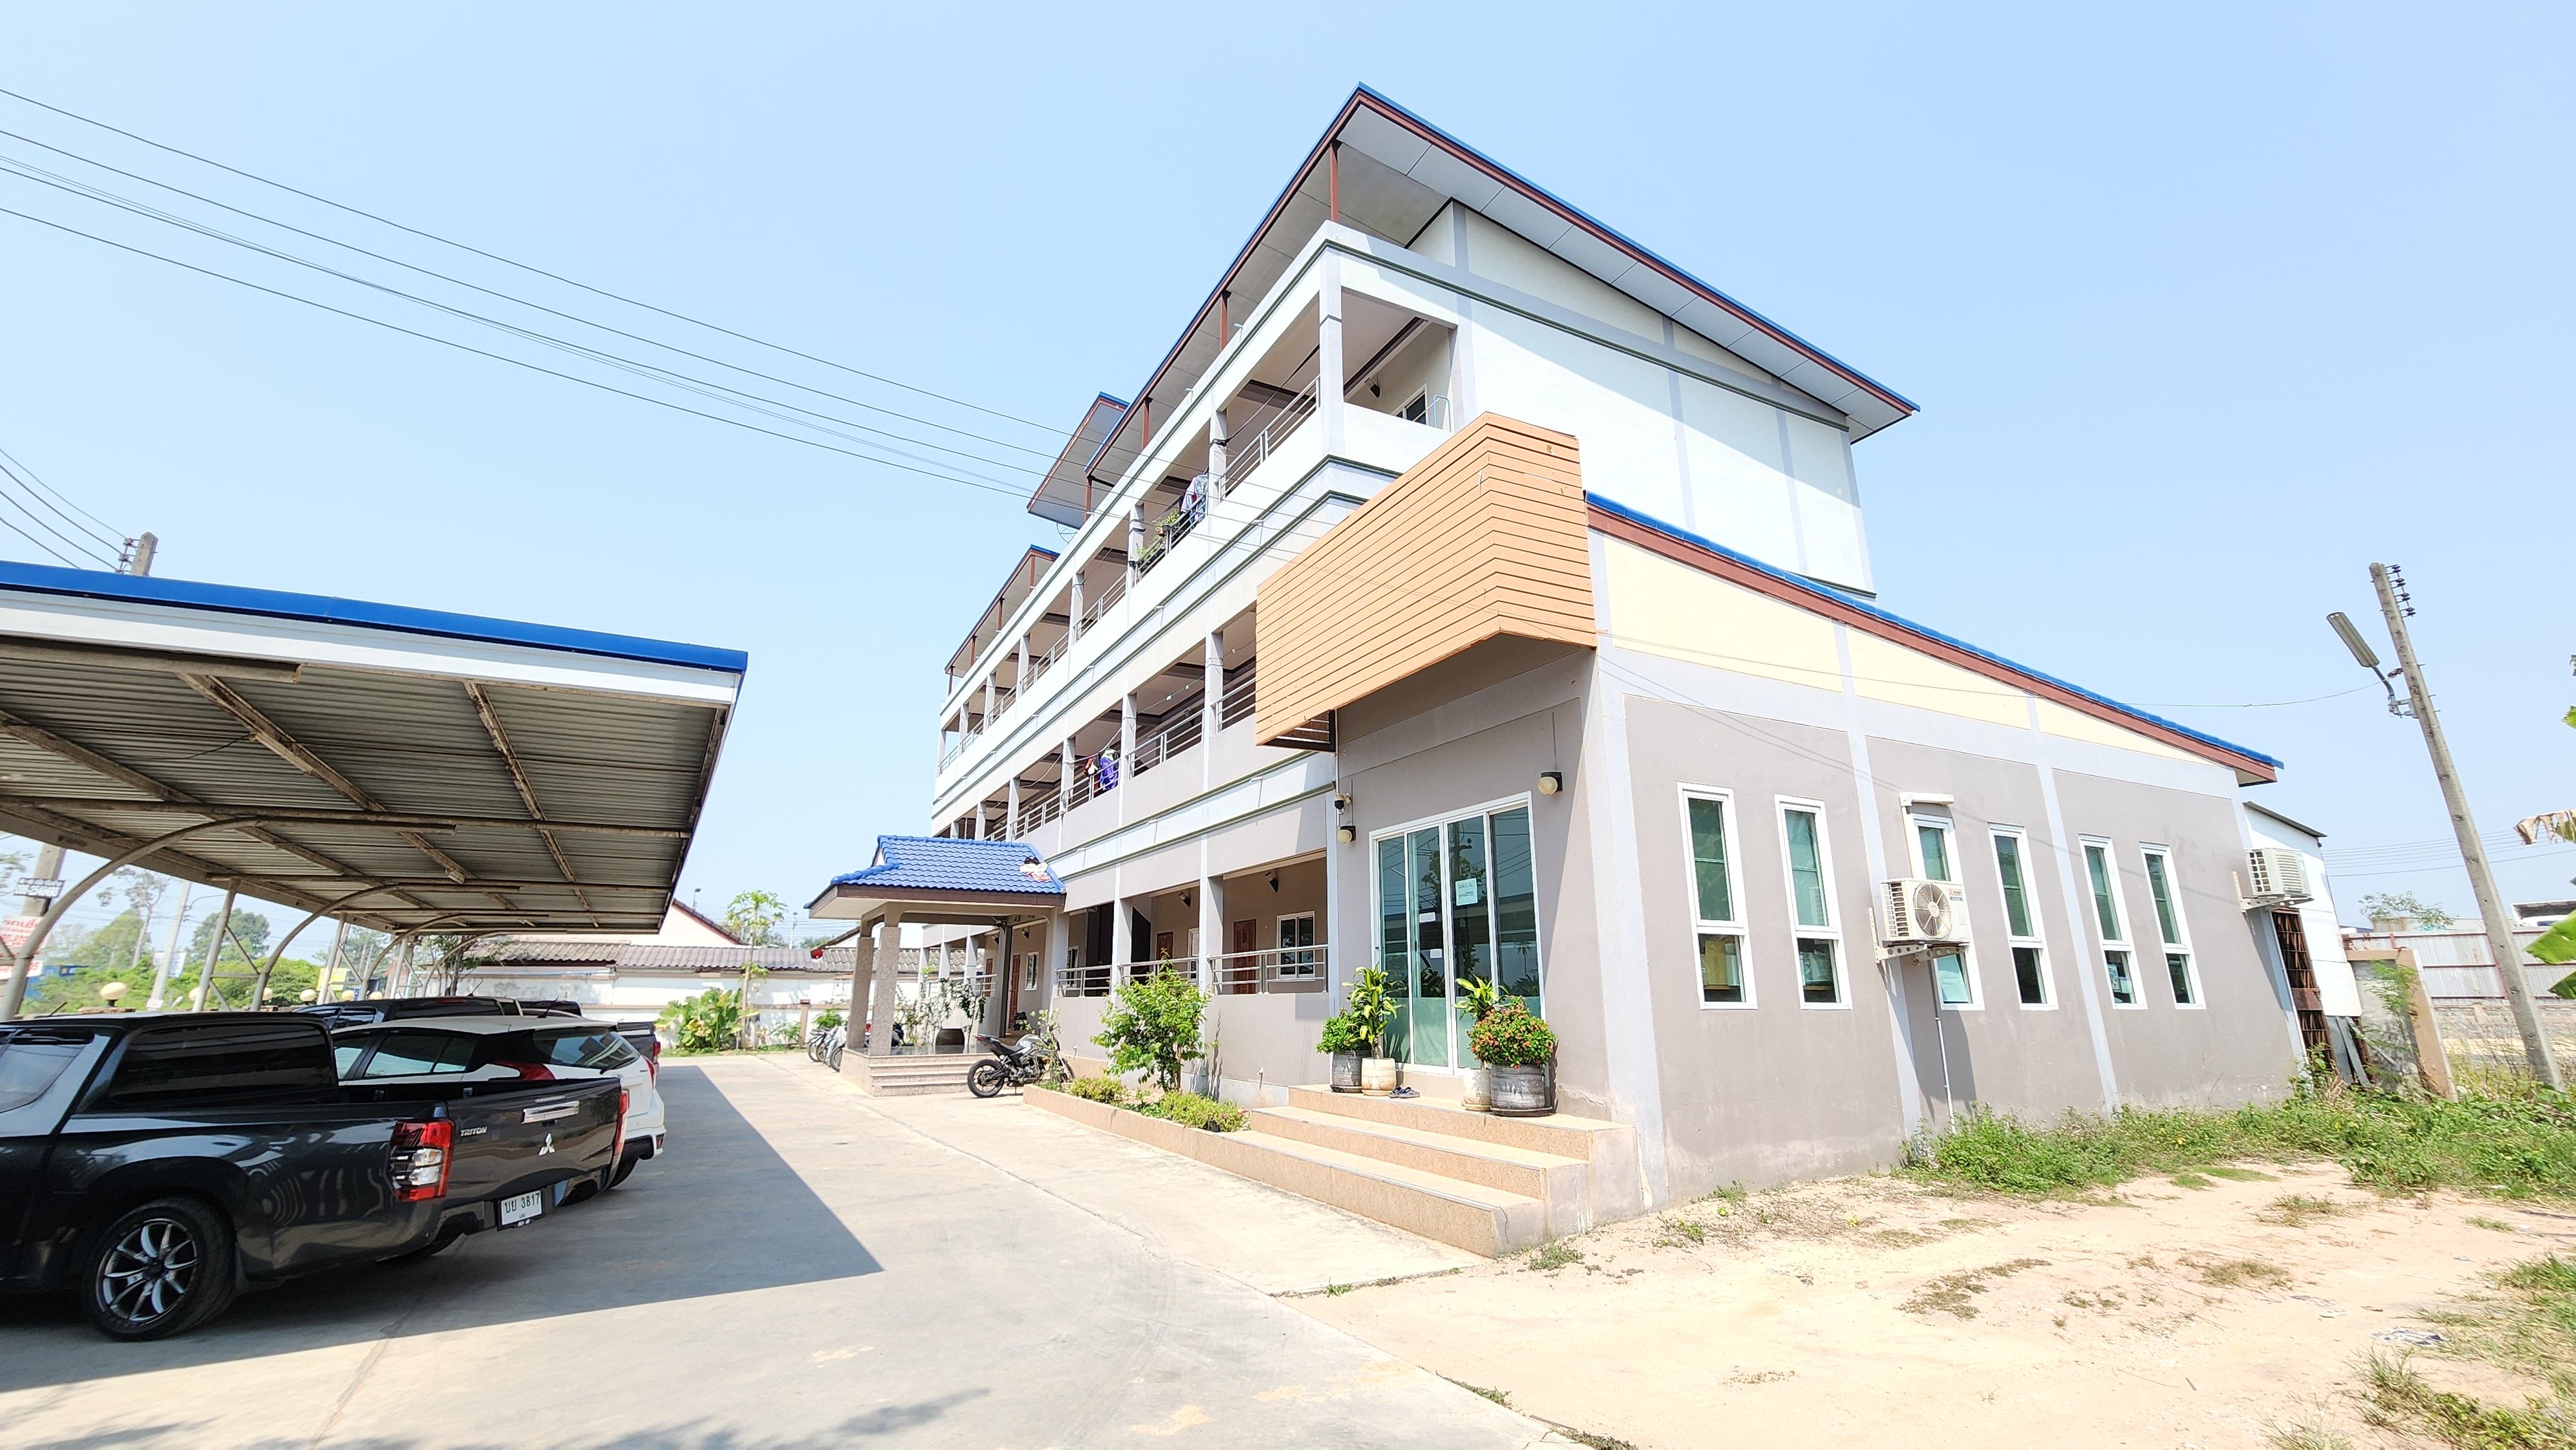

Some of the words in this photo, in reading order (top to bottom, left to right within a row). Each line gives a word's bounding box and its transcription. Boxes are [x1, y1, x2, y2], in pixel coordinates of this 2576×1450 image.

[460, 1127, 487, 1136] TRITON
[504, 1200, 517, 1214] บย
[521, 1192, 540, 1209] 3817
